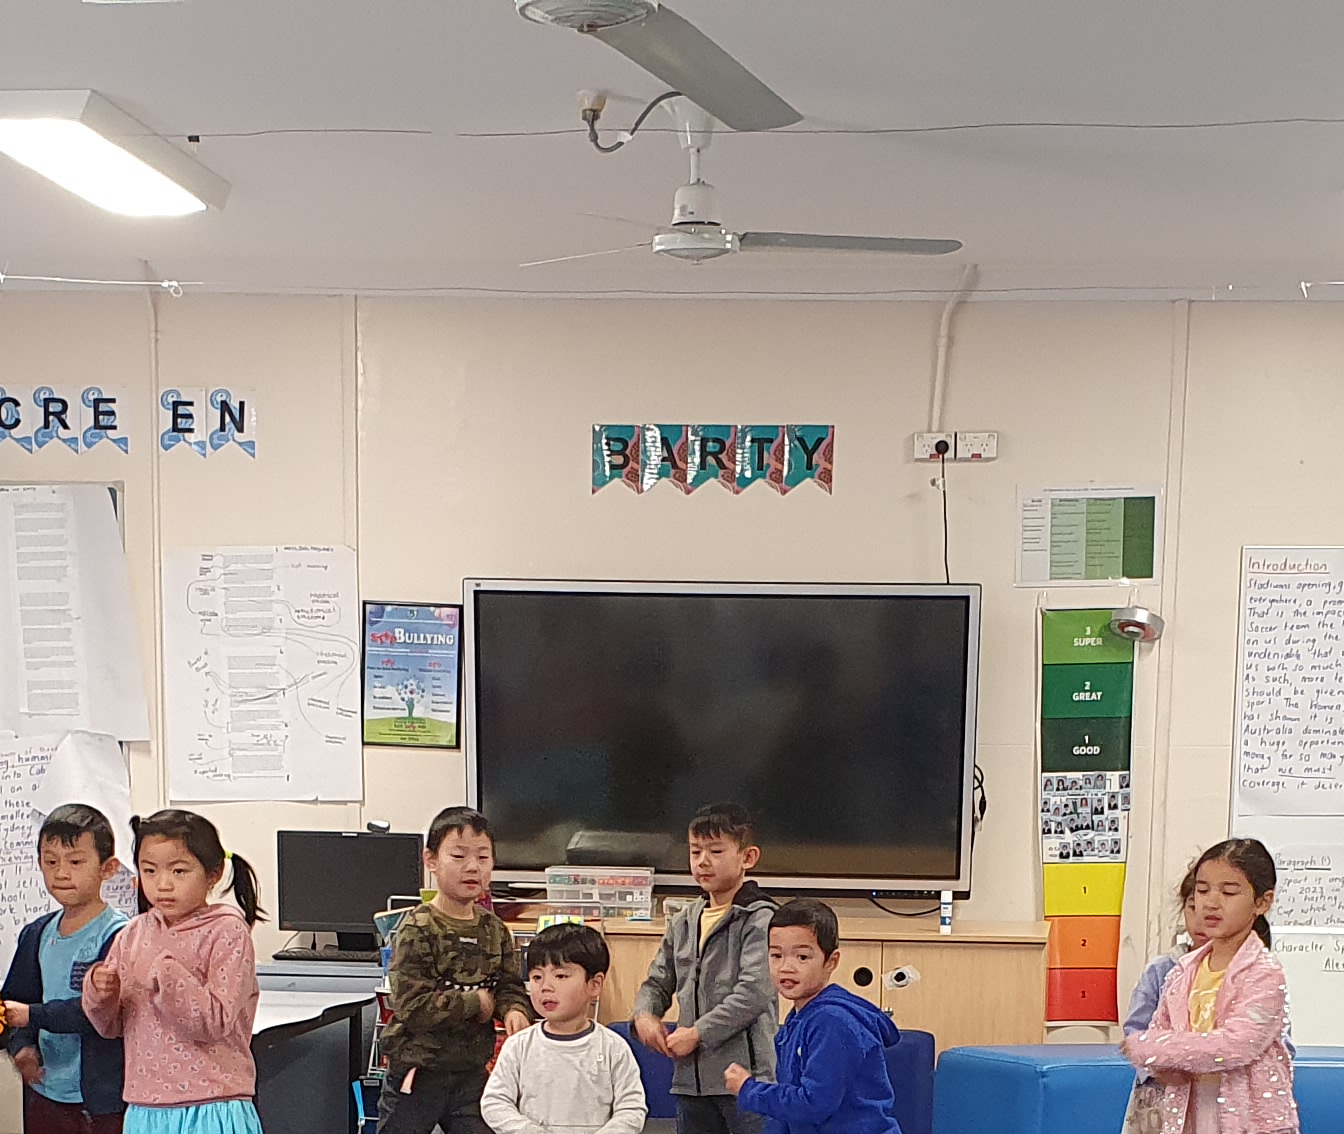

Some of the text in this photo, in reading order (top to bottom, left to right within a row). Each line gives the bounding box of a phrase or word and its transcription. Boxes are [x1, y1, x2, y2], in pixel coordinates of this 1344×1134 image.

[606, 437, 826, 470] BARTY
[1248, 557, 1327, 572] Introduction
[1086, 627, 1091, 635] 3
[1074, 638, 1102, 646] SUPER
[1085, 682, 1090, 690] 2
[1073, 692, 1102, 701] GREAT
[1073, 746, 1100, 754] GOOD
